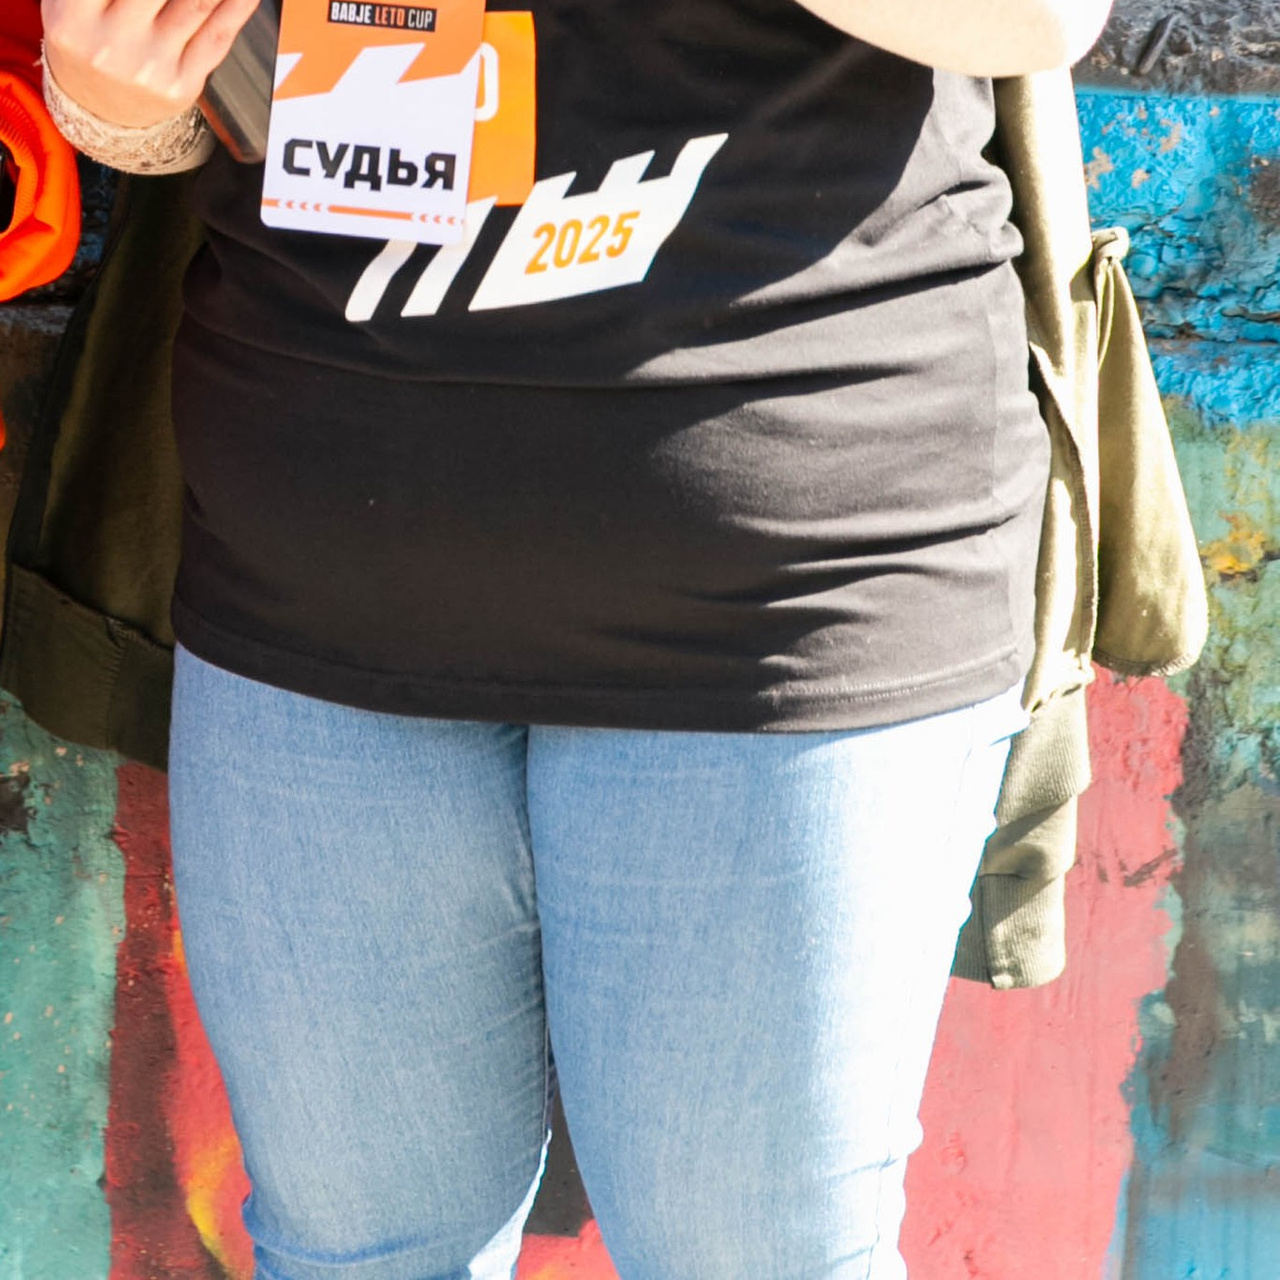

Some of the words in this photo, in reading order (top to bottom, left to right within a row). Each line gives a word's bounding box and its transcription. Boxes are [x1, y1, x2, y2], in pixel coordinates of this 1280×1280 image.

[331, 2, 372, 24] BABJE
[375, 6, 405, 27] LETO
[408, 9, 433, 29] CUP
[282, 138, 457, 192] СУДЬЯ
[524, 211, 640, 274] 2025
